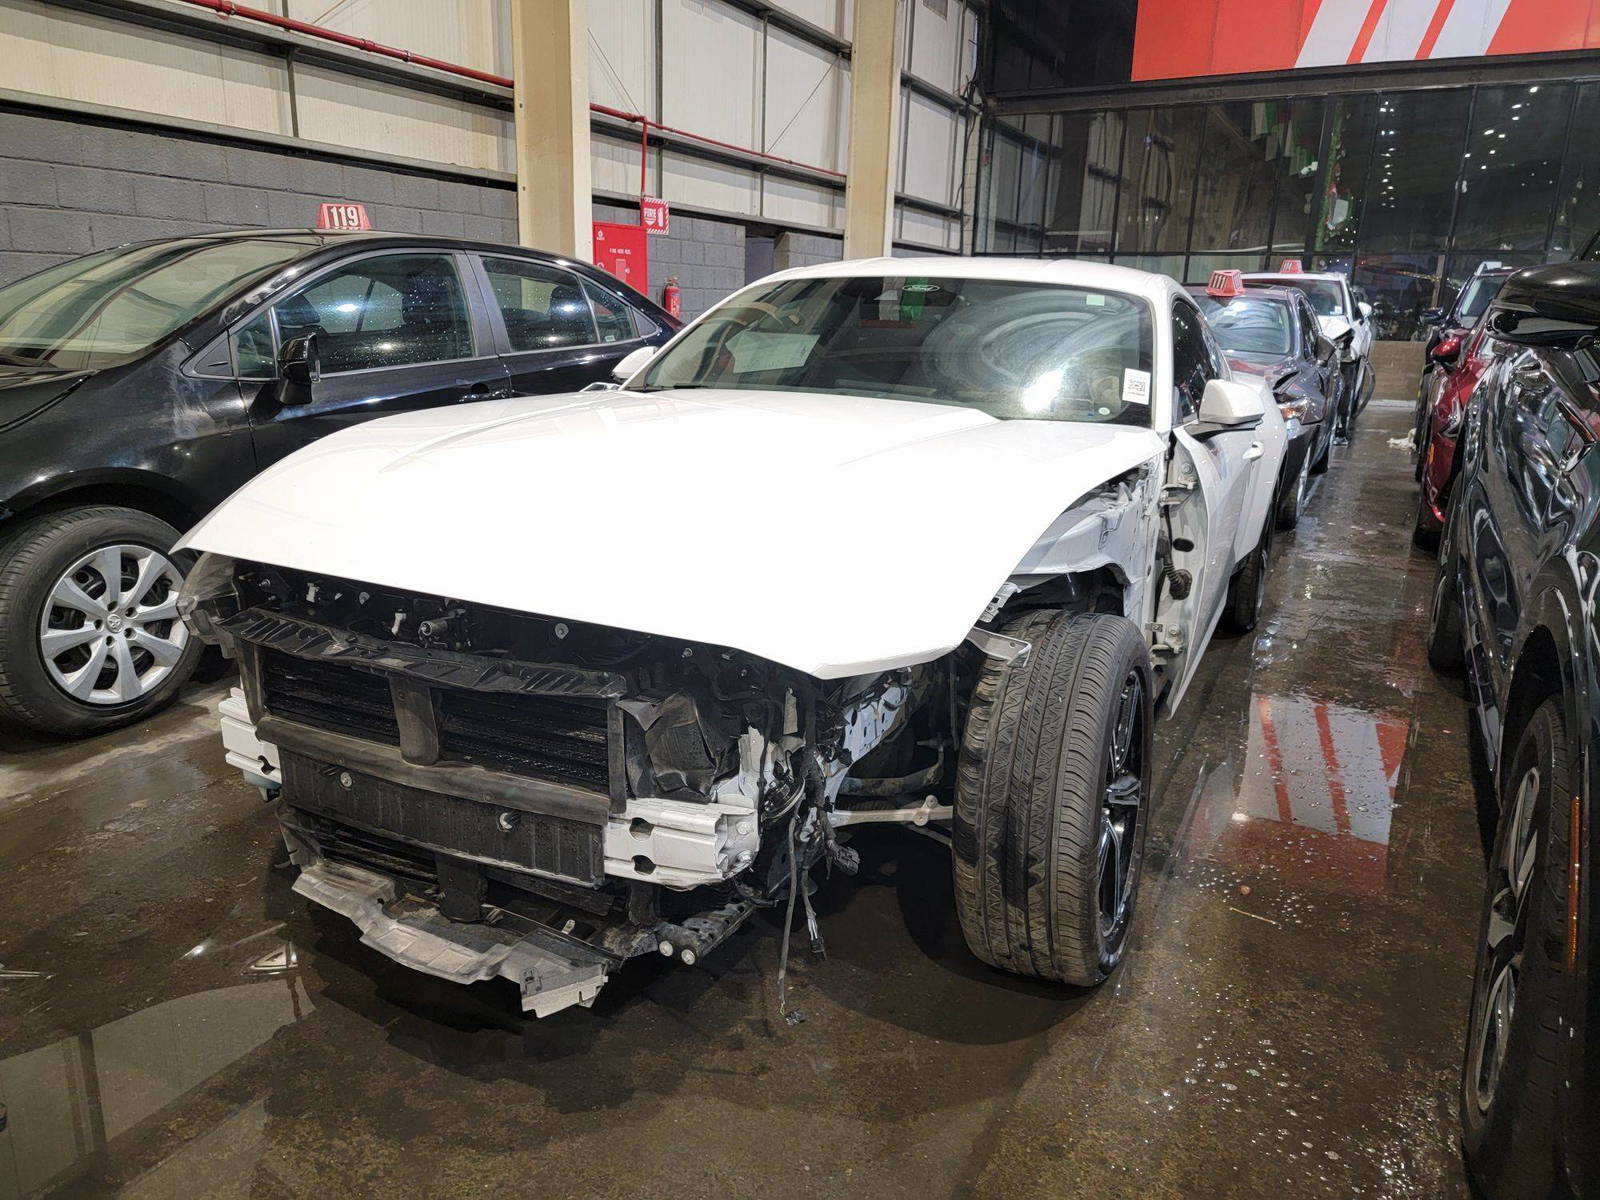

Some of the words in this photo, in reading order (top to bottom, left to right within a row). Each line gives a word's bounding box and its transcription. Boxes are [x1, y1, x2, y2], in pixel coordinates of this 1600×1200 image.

[330, 206, 359, 227] 119
[643, 207, 657, 219] FIRE
[1212, 274, 1227, 289] 111
